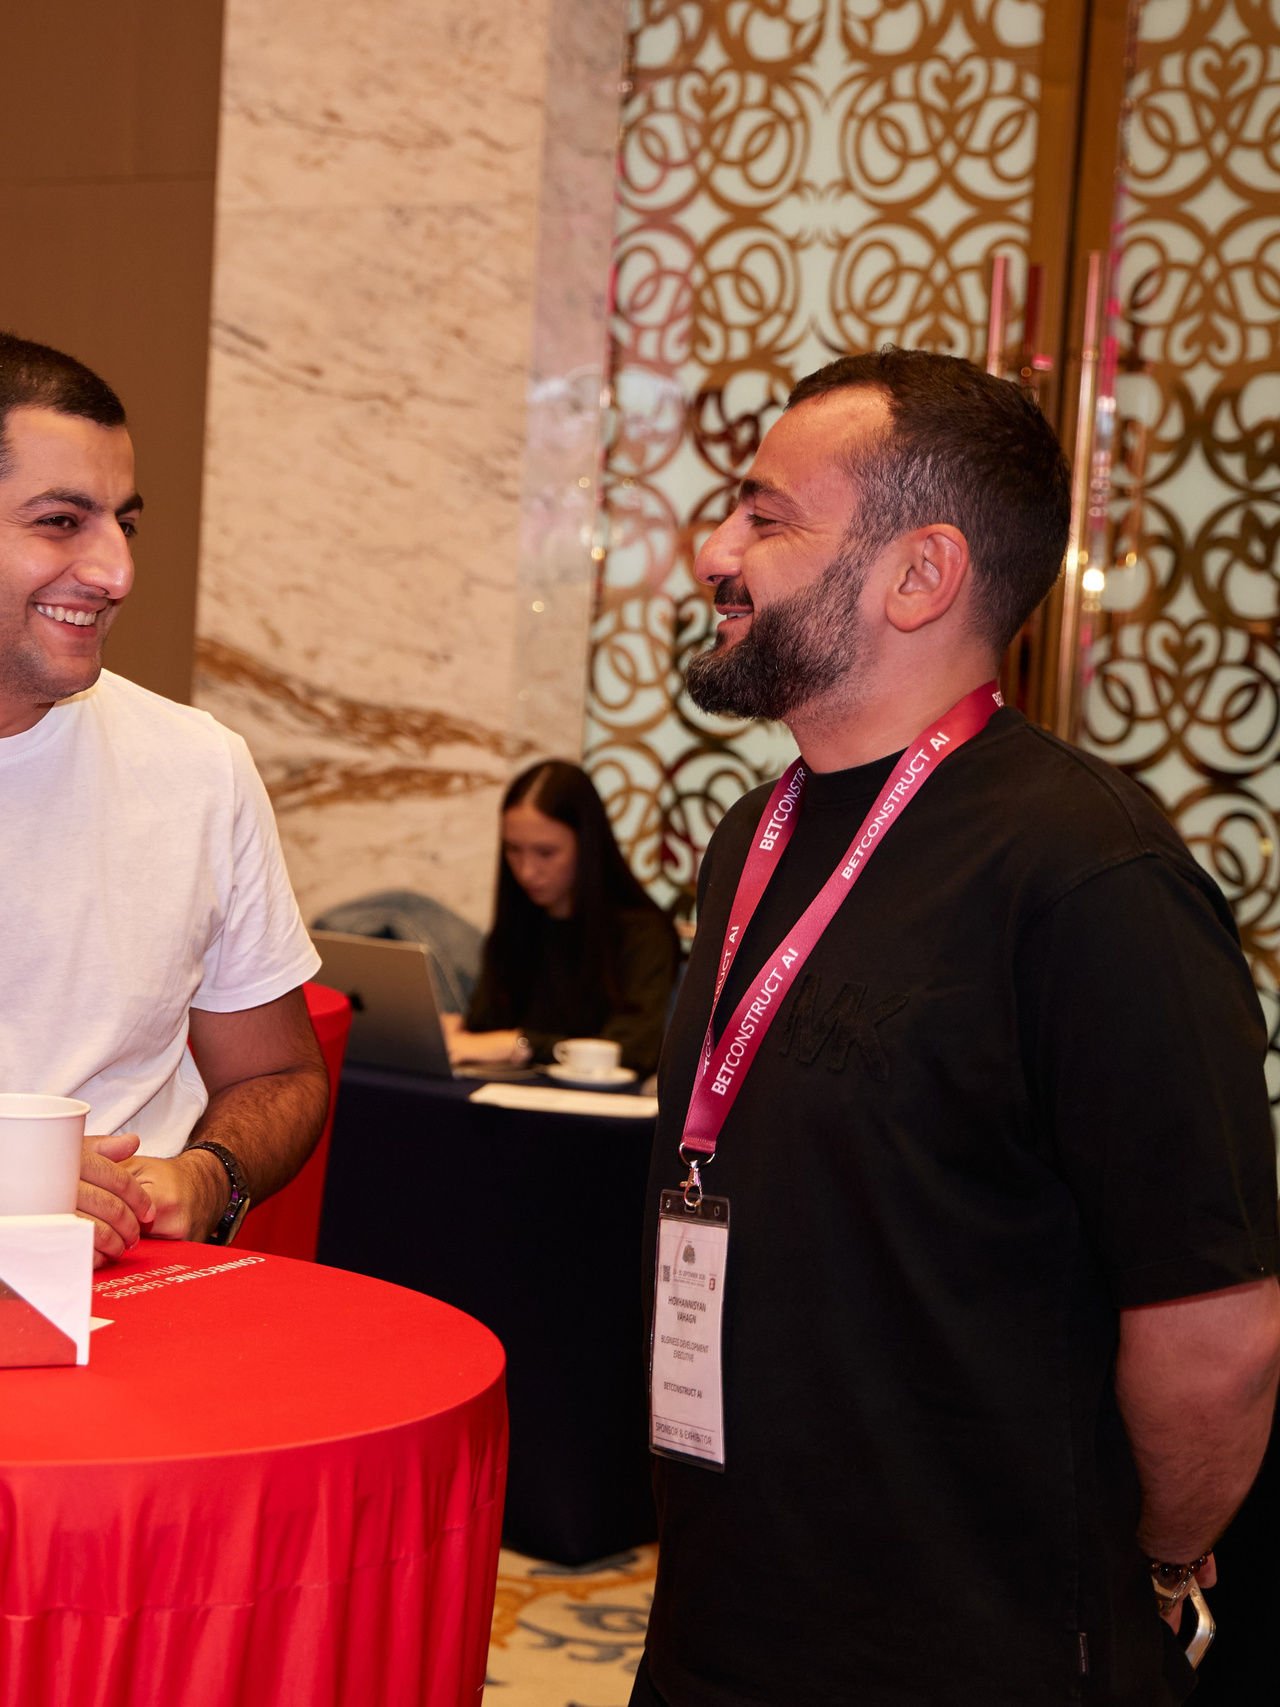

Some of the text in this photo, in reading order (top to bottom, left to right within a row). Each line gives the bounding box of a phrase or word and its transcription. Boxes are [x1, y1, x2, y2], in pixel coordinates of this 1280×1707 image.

[759, 767, 806, 851] BETCONSTR
[841, 731, 950, 880] BETCONSTRUCT AI
[711, 946, 800, 1096] BETCONSTRUCT AI
[102, 1256, 266, 1299] CONNECTING LEADERS
[147, 1264, 191, 1277] WITH
